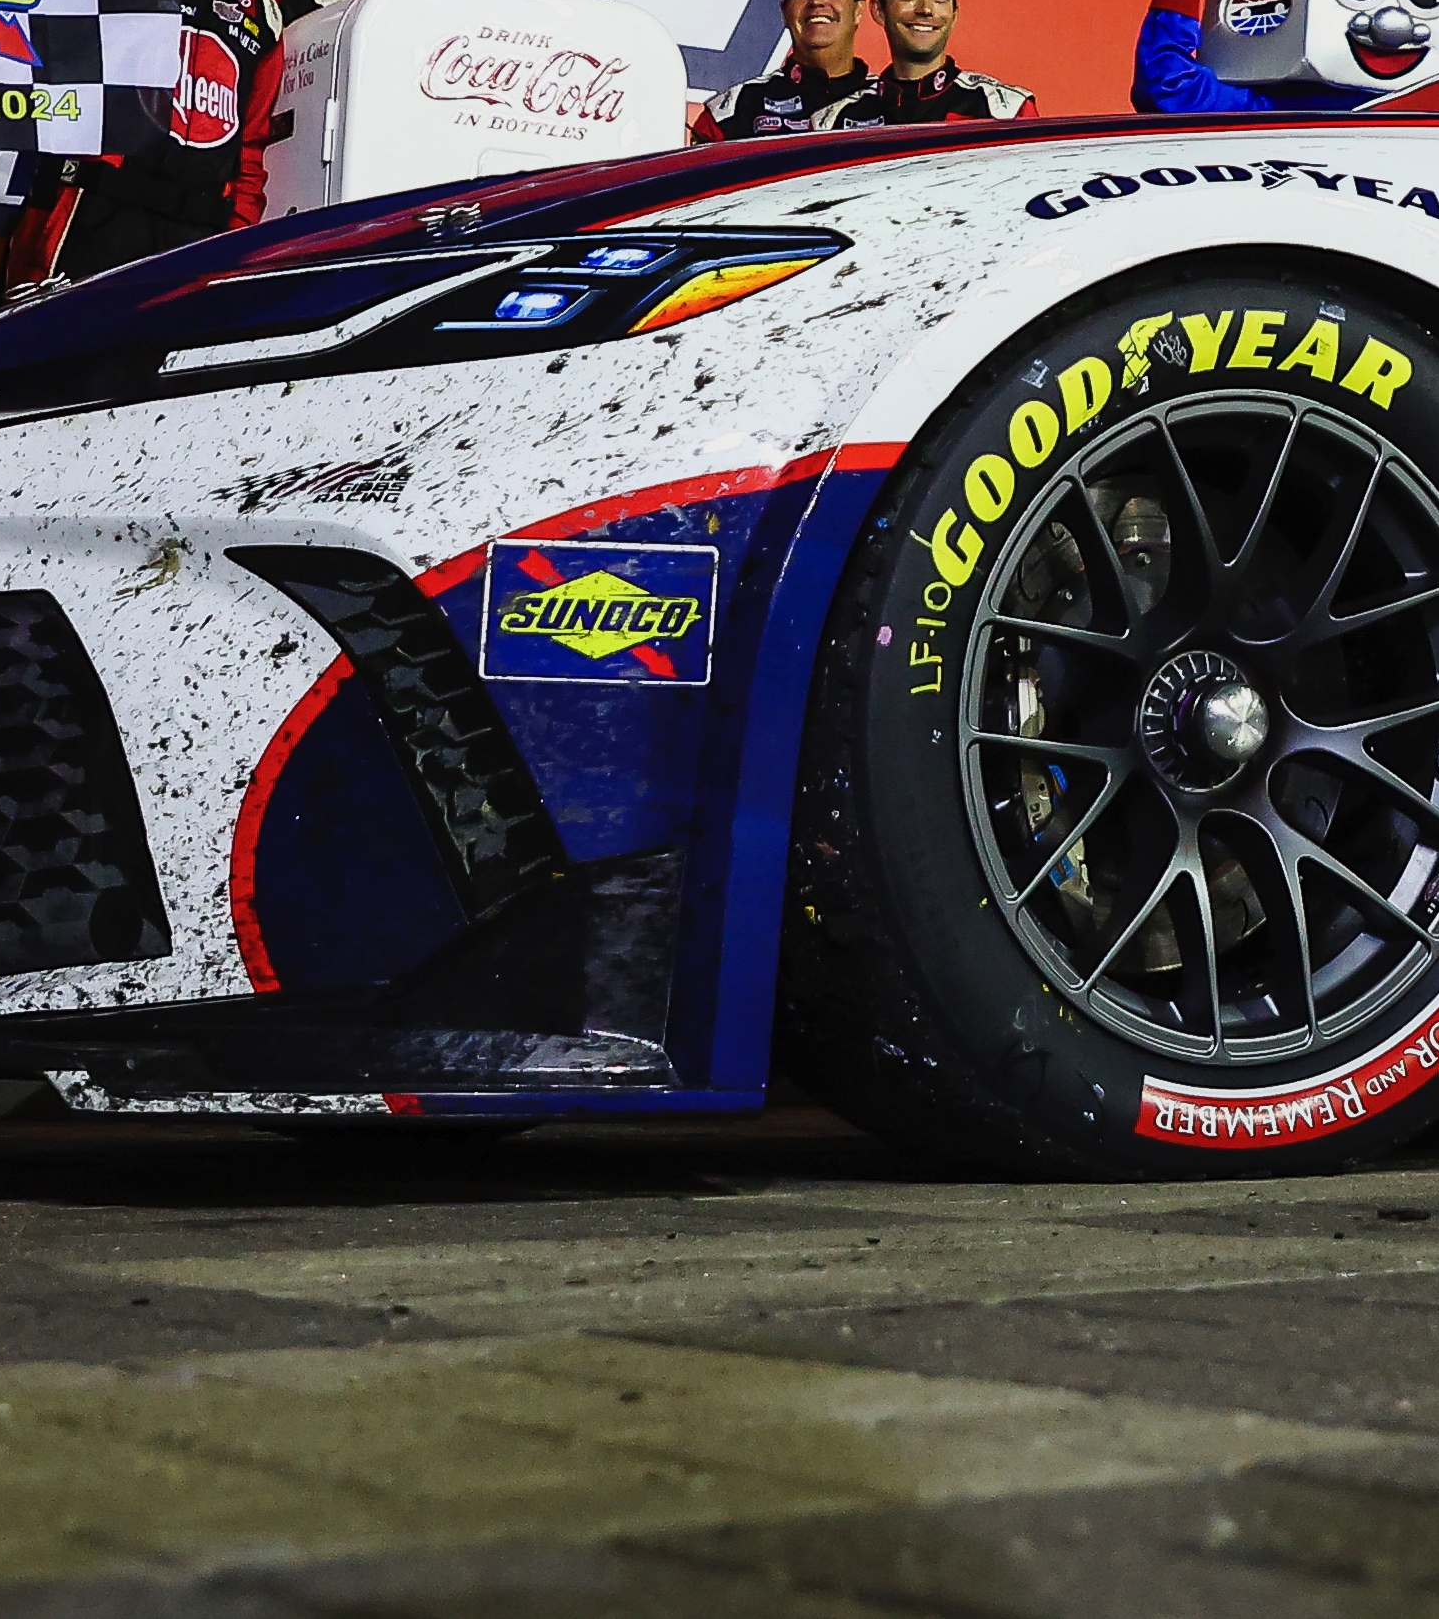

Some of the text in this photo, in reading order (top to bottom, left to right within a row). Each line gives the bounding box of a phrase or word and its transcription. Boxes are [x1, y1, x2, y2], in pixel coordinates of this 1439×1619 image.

[476, 26, 553, 49] DRINK
[173, 32, 235, 125] heem
[298, 70, 315, 90] You
[420, 35, 631, 122] Coca-Cola
[454, 112, 588, 141] IN BOTTLES
[931, 309, 1413, 587] GOODYEAR
[313, 493, 401, 503] RACING
[336, 482, 408, 493] GIBBS
[506, 595, 695, 637] SUNOCO
[1366, 1059, 1408, 1094] AND
[1154, 1079, 1366, 1138] REMEMBER
